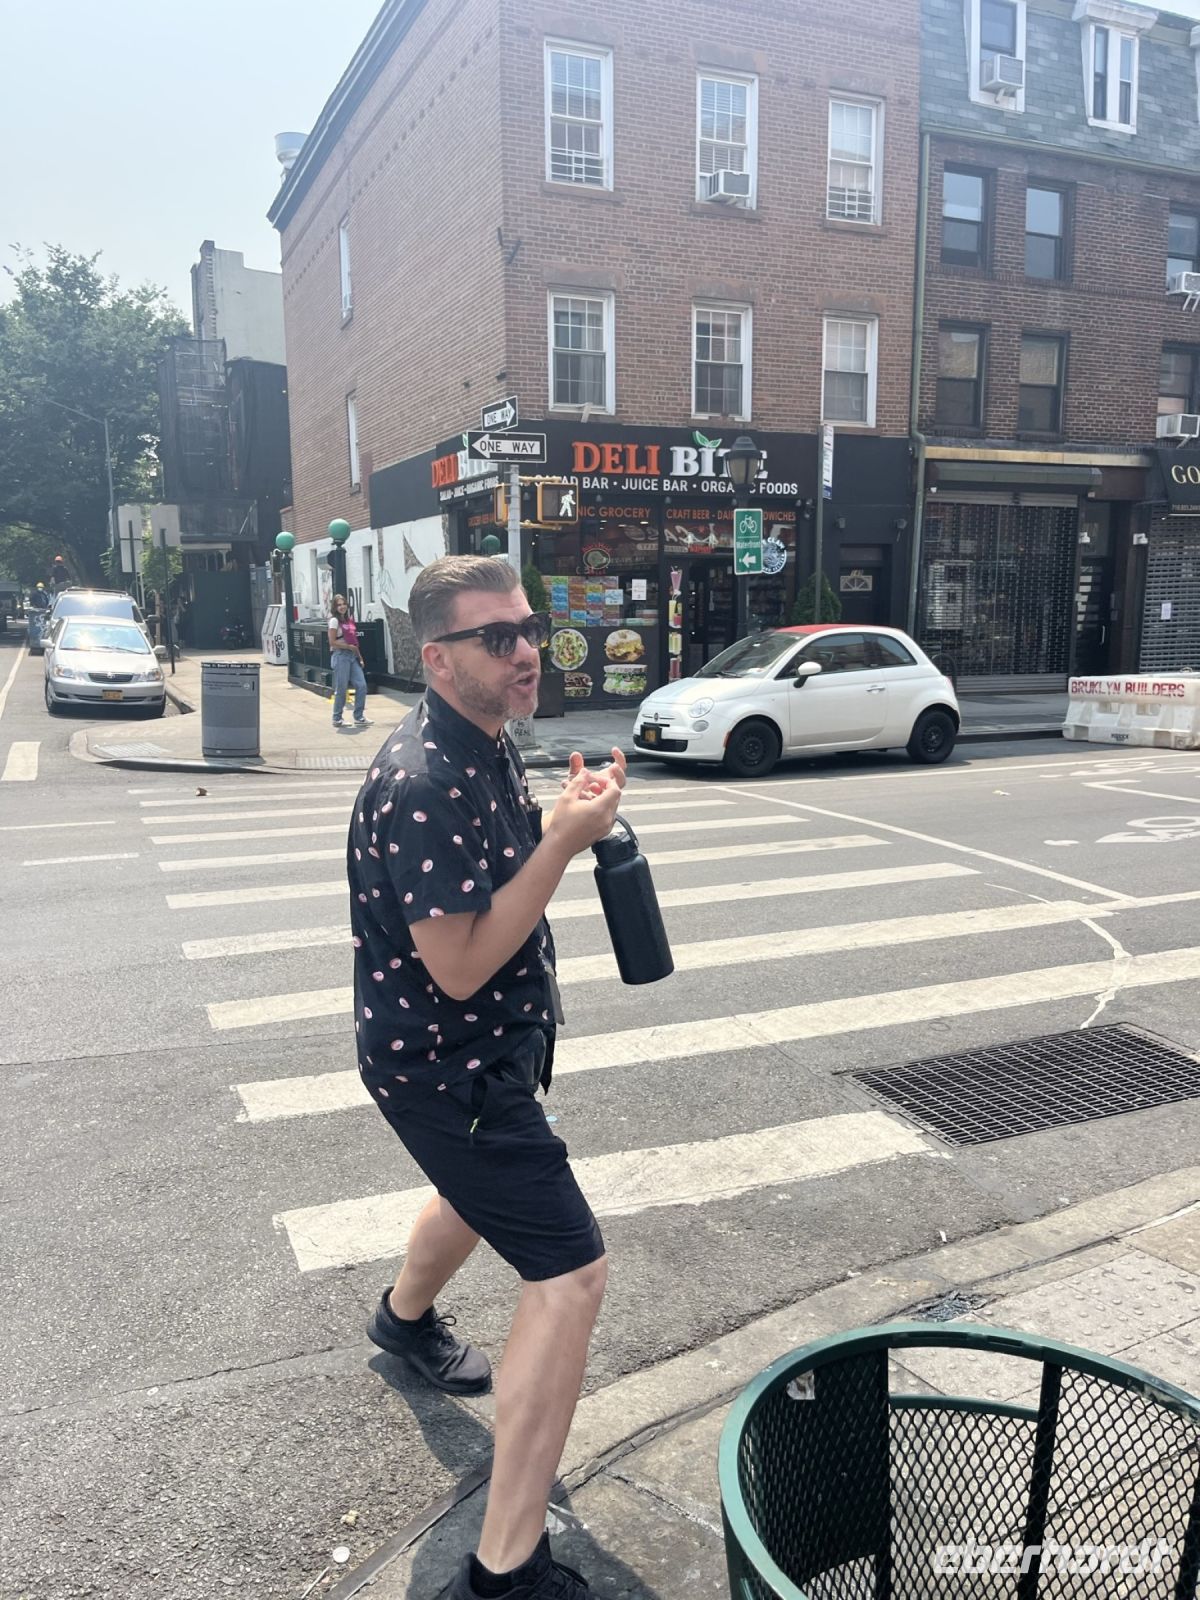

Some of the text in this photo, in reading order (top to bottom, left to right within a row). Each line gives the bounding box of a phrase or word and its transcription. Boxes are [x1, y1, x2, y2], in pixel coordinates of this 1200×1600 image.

[487, 407, 512, 425] ONE WAY
[480, 440, 535, 453] ONE WAY
[572, 441, 660, 475] DELI
[431, 453, 457, 488] DELI
[582, 476, 609, 489] BAR
[621, 478, 659, 491] JUICE
[663, 479, 688, 492] BAR
[759, 482, 798, 495] FOODS
[599, 506, 651, 518] GROCERY
[666, 508, 690, 519] CRAFT
[692, 508, 710, 520] BEER
[1071, 681, 1185, 698] BRUKLYN BUILDERS
